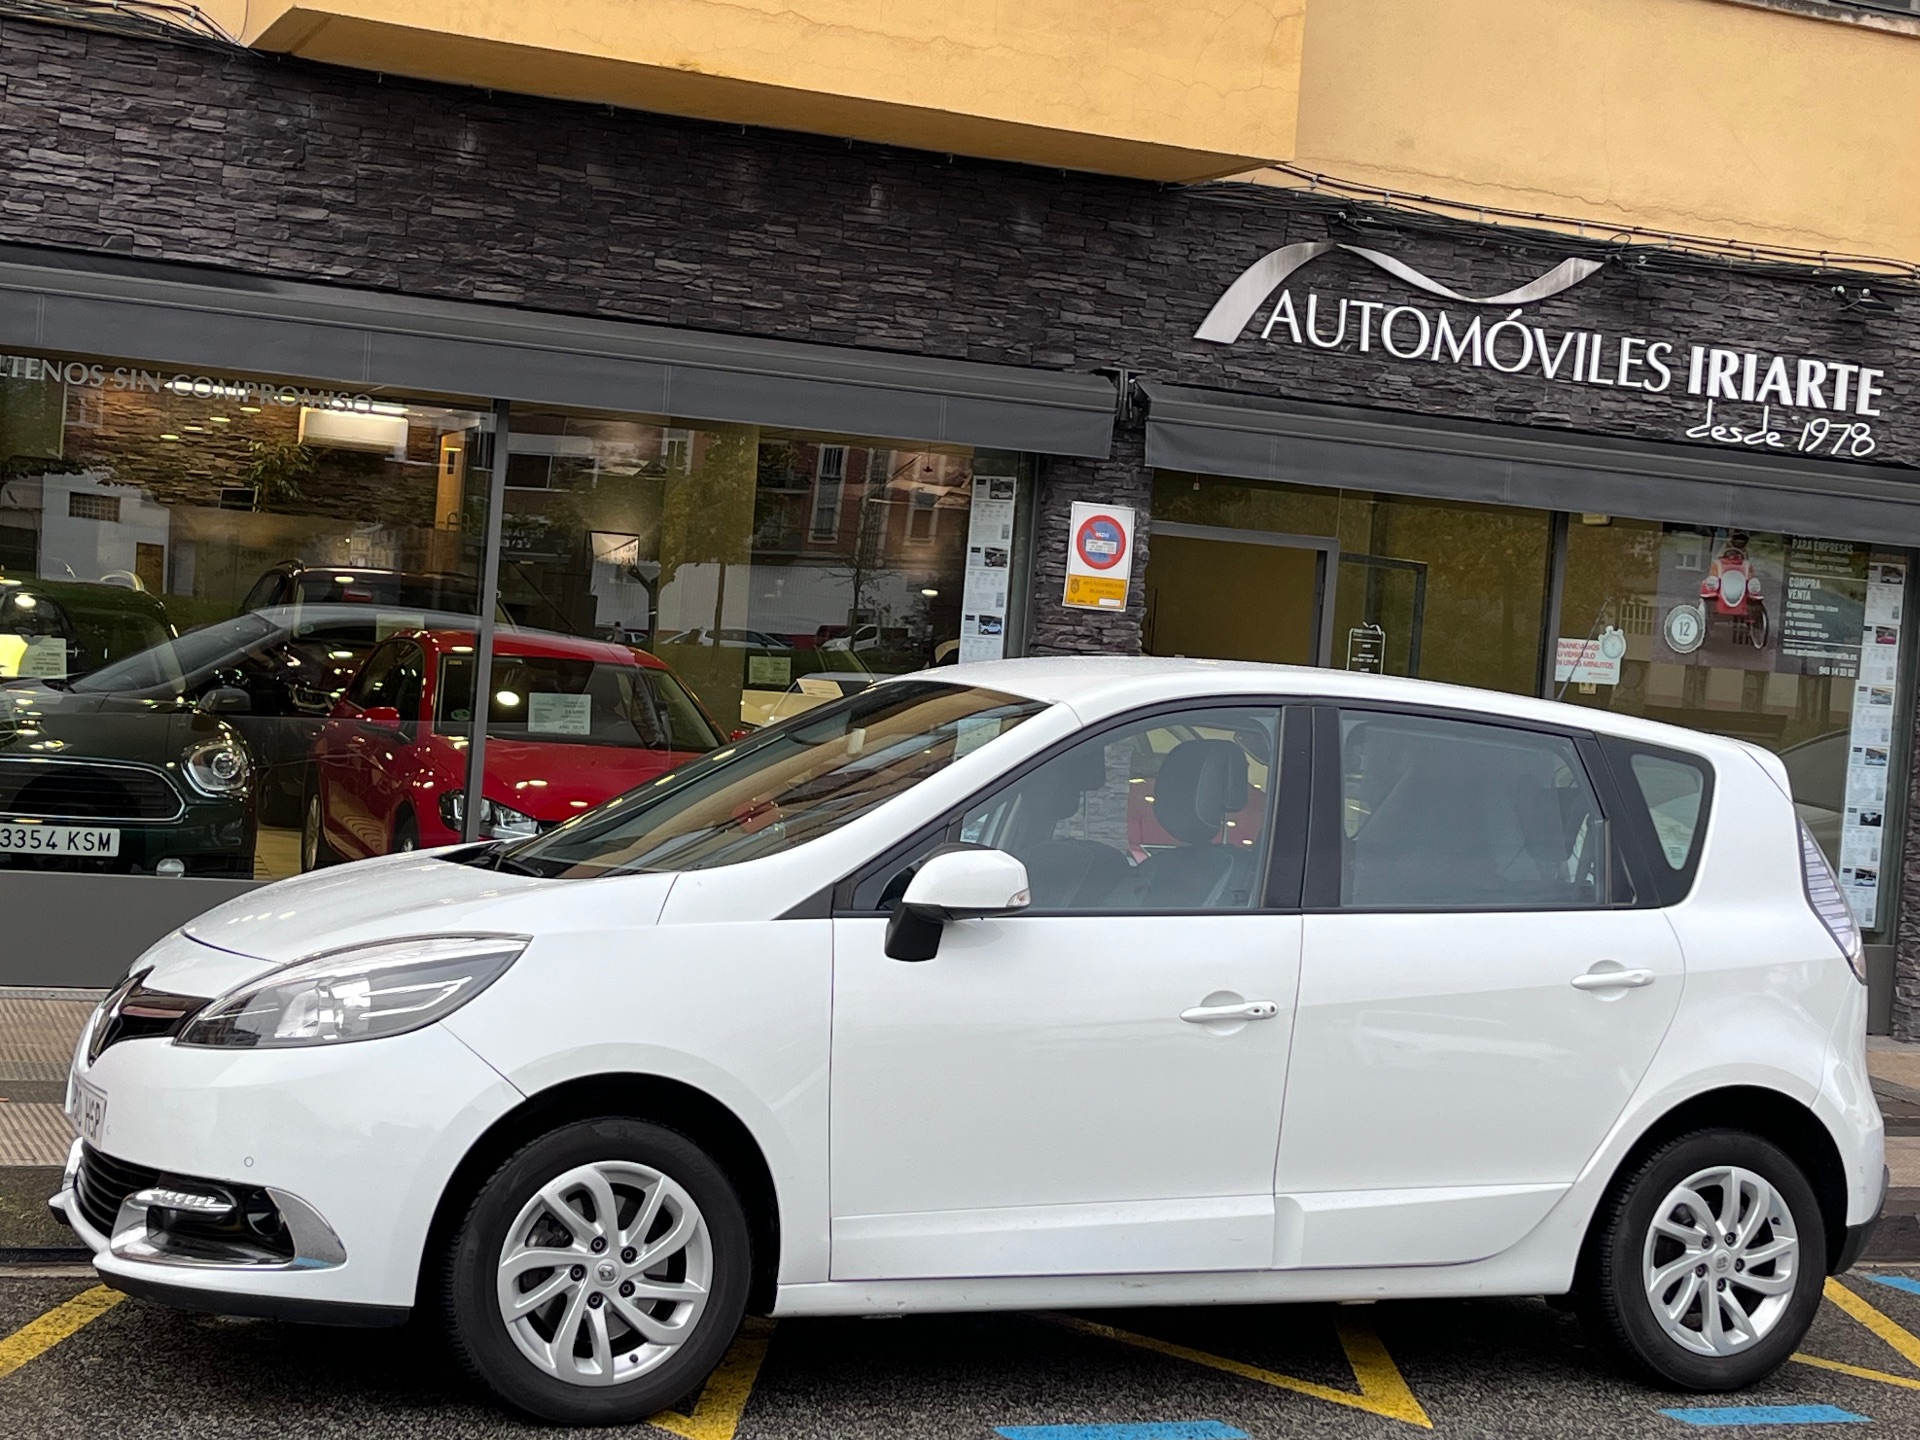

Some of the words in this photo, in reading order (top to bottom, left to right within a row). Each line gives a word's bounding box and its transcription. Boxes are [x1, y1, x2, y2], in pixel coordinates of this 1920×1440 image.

[1260, 289, 1673, 392] AUTOMÓVILES
[1687, 345, 1884, 417] IRIARTE
[113, 367, 161, 393] SIN
[171, 373, 373, 413] COMPROMISO
[1685, 398, 1785, 447] desde
[1797, 417, 1876, 456] 1978
[1787, 588, 1812, 601] VENTA
[1788, 577, 1821, 590] COMPRA
[1679, 621, 1691, 637] 12
[0, 828, 58, 850] 3354
[67, 830, 112, 852] KSM
